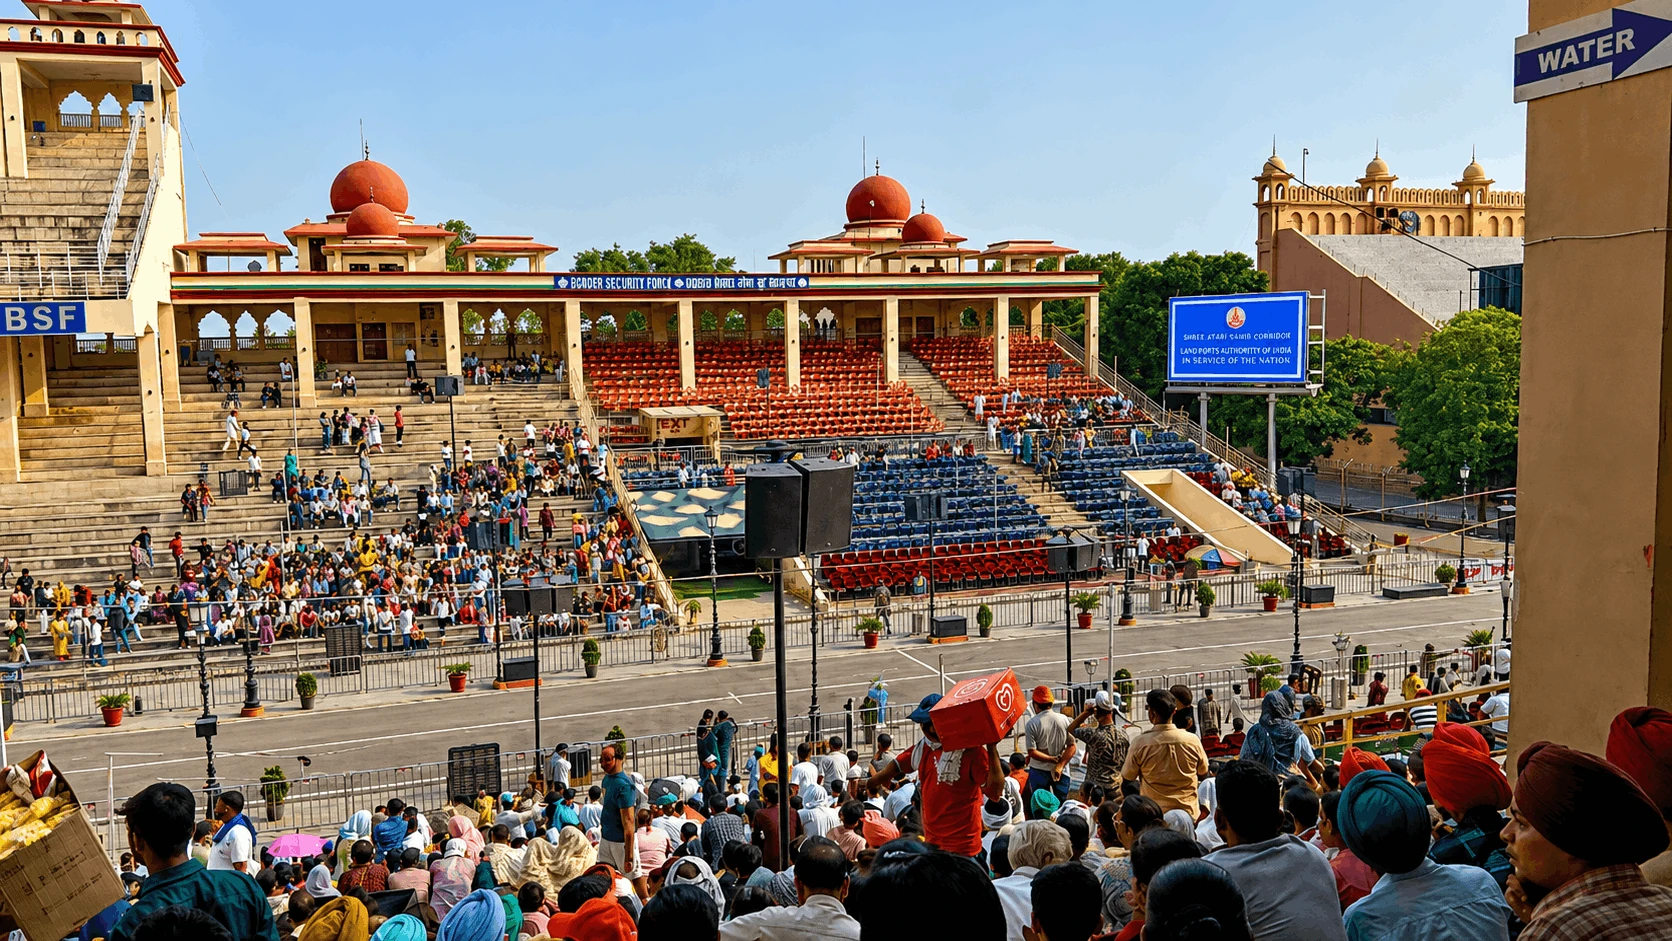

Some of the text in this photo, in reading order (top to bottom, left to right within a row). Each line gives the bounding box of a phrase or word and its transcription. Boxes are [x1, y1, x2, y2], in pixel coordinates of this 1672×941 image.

[1538, 28, 1635, 74] WATER
[5, 305, 76, 331] BSF
[1180, 347, 1198, 355] LAND
[1198, 347, 1220, 355] PORTS
